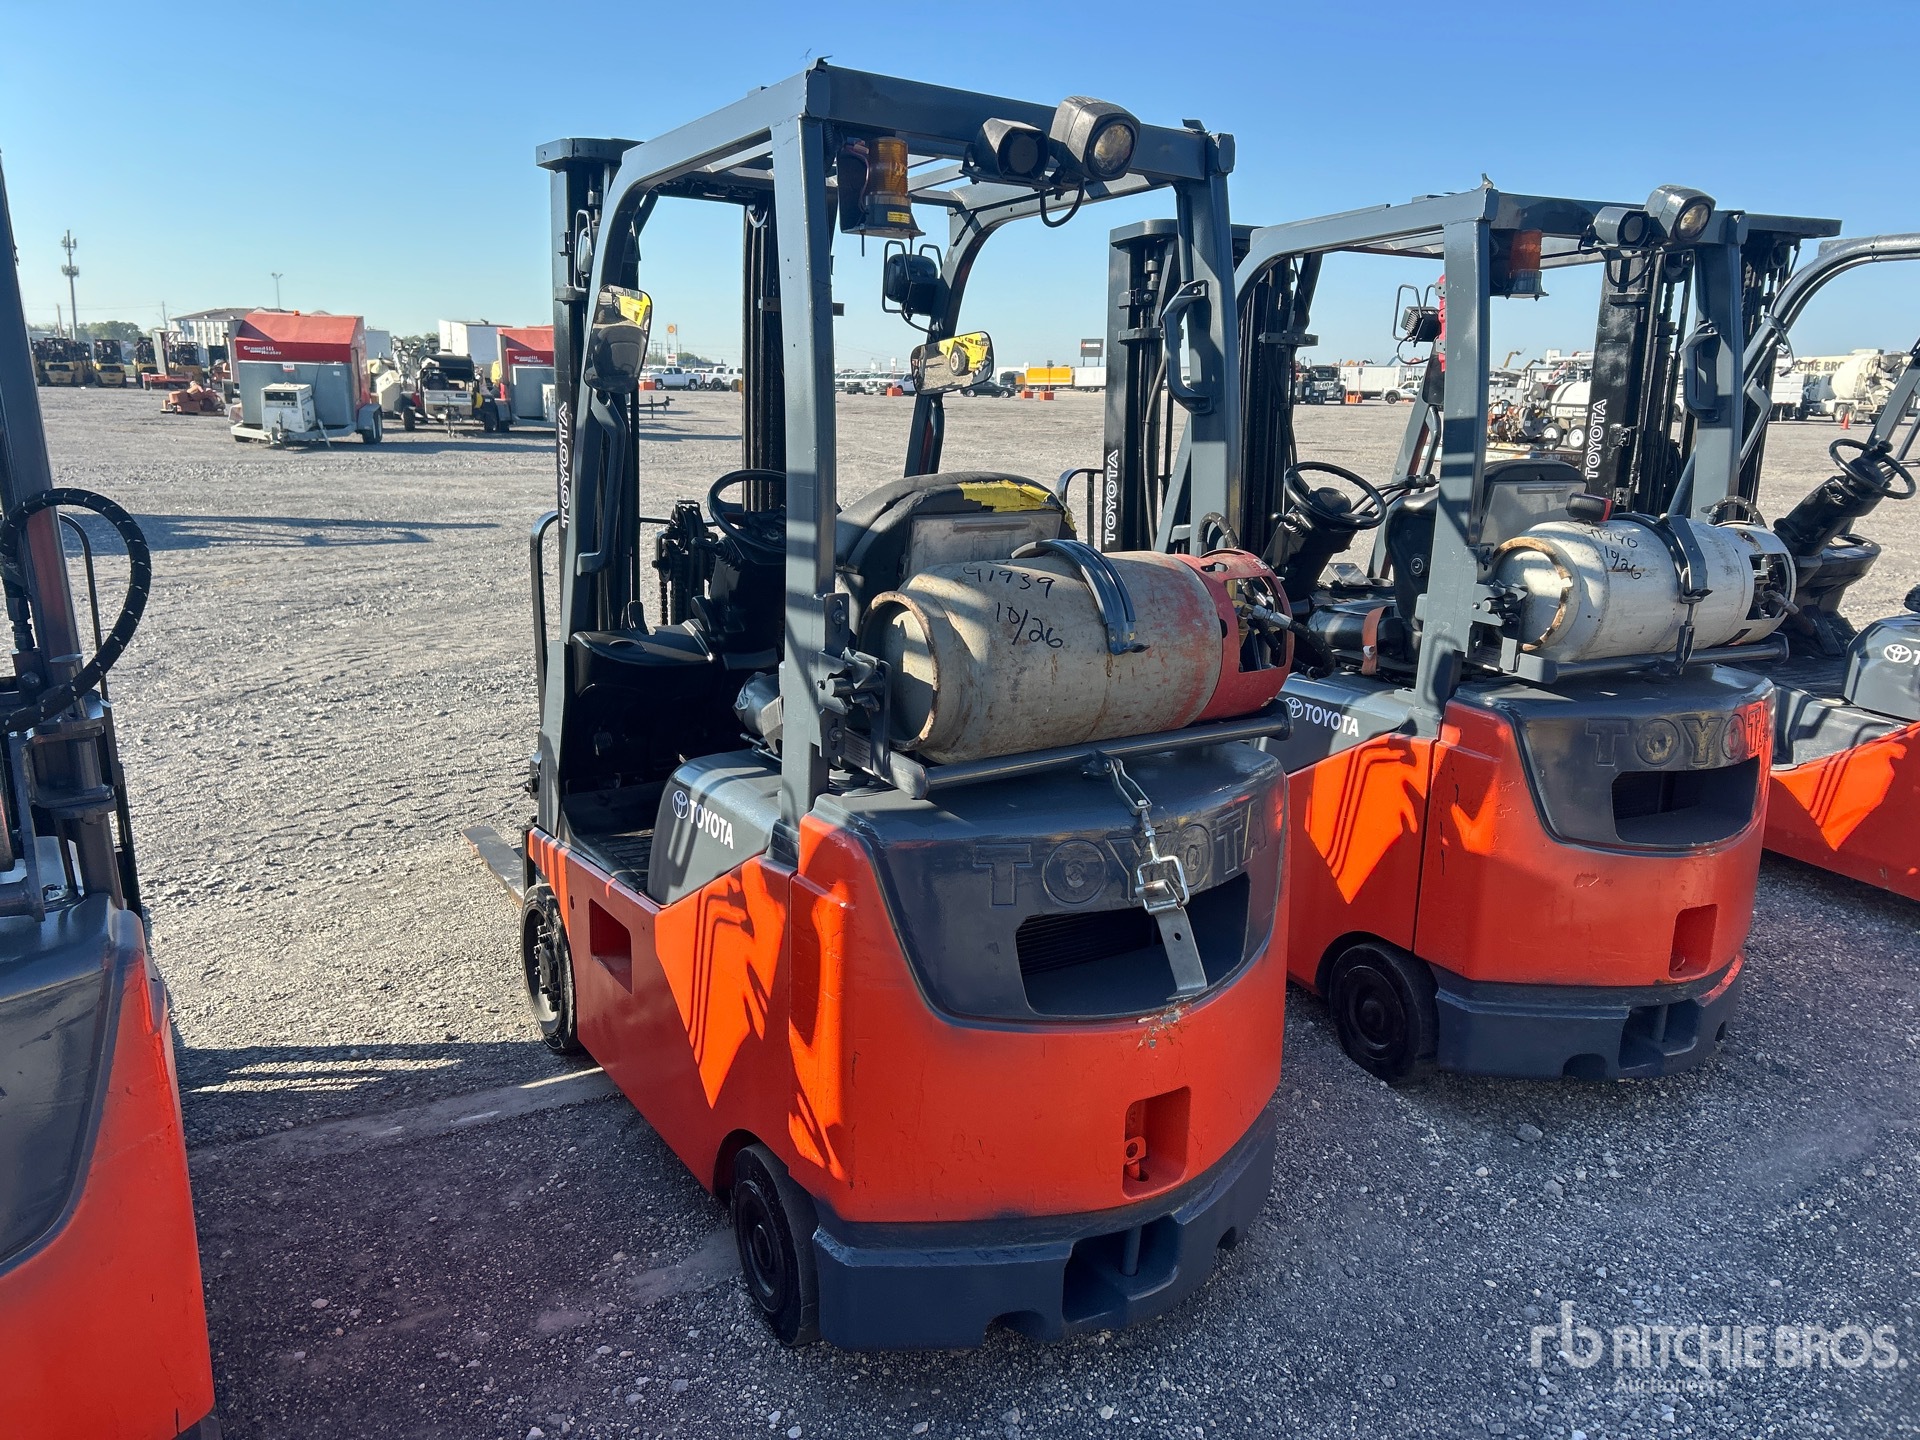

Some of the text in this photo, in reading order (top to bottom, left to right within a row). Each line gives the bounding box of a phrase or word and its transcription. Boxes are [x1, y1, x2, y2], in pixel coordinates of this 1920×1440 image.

[1584, 399, 1607, 479] TOYOTA
[559, 401, 570, 529] TOYOTA
[1105, 449, 1119, 545] TOYOTA
[962, 565, 1056, 599] 41939
[995, 601, 1064, 649] 10/26
[1304, 703, 1359, 738] TOYOTA
[689, 799, 734, 850] TOYOTA
